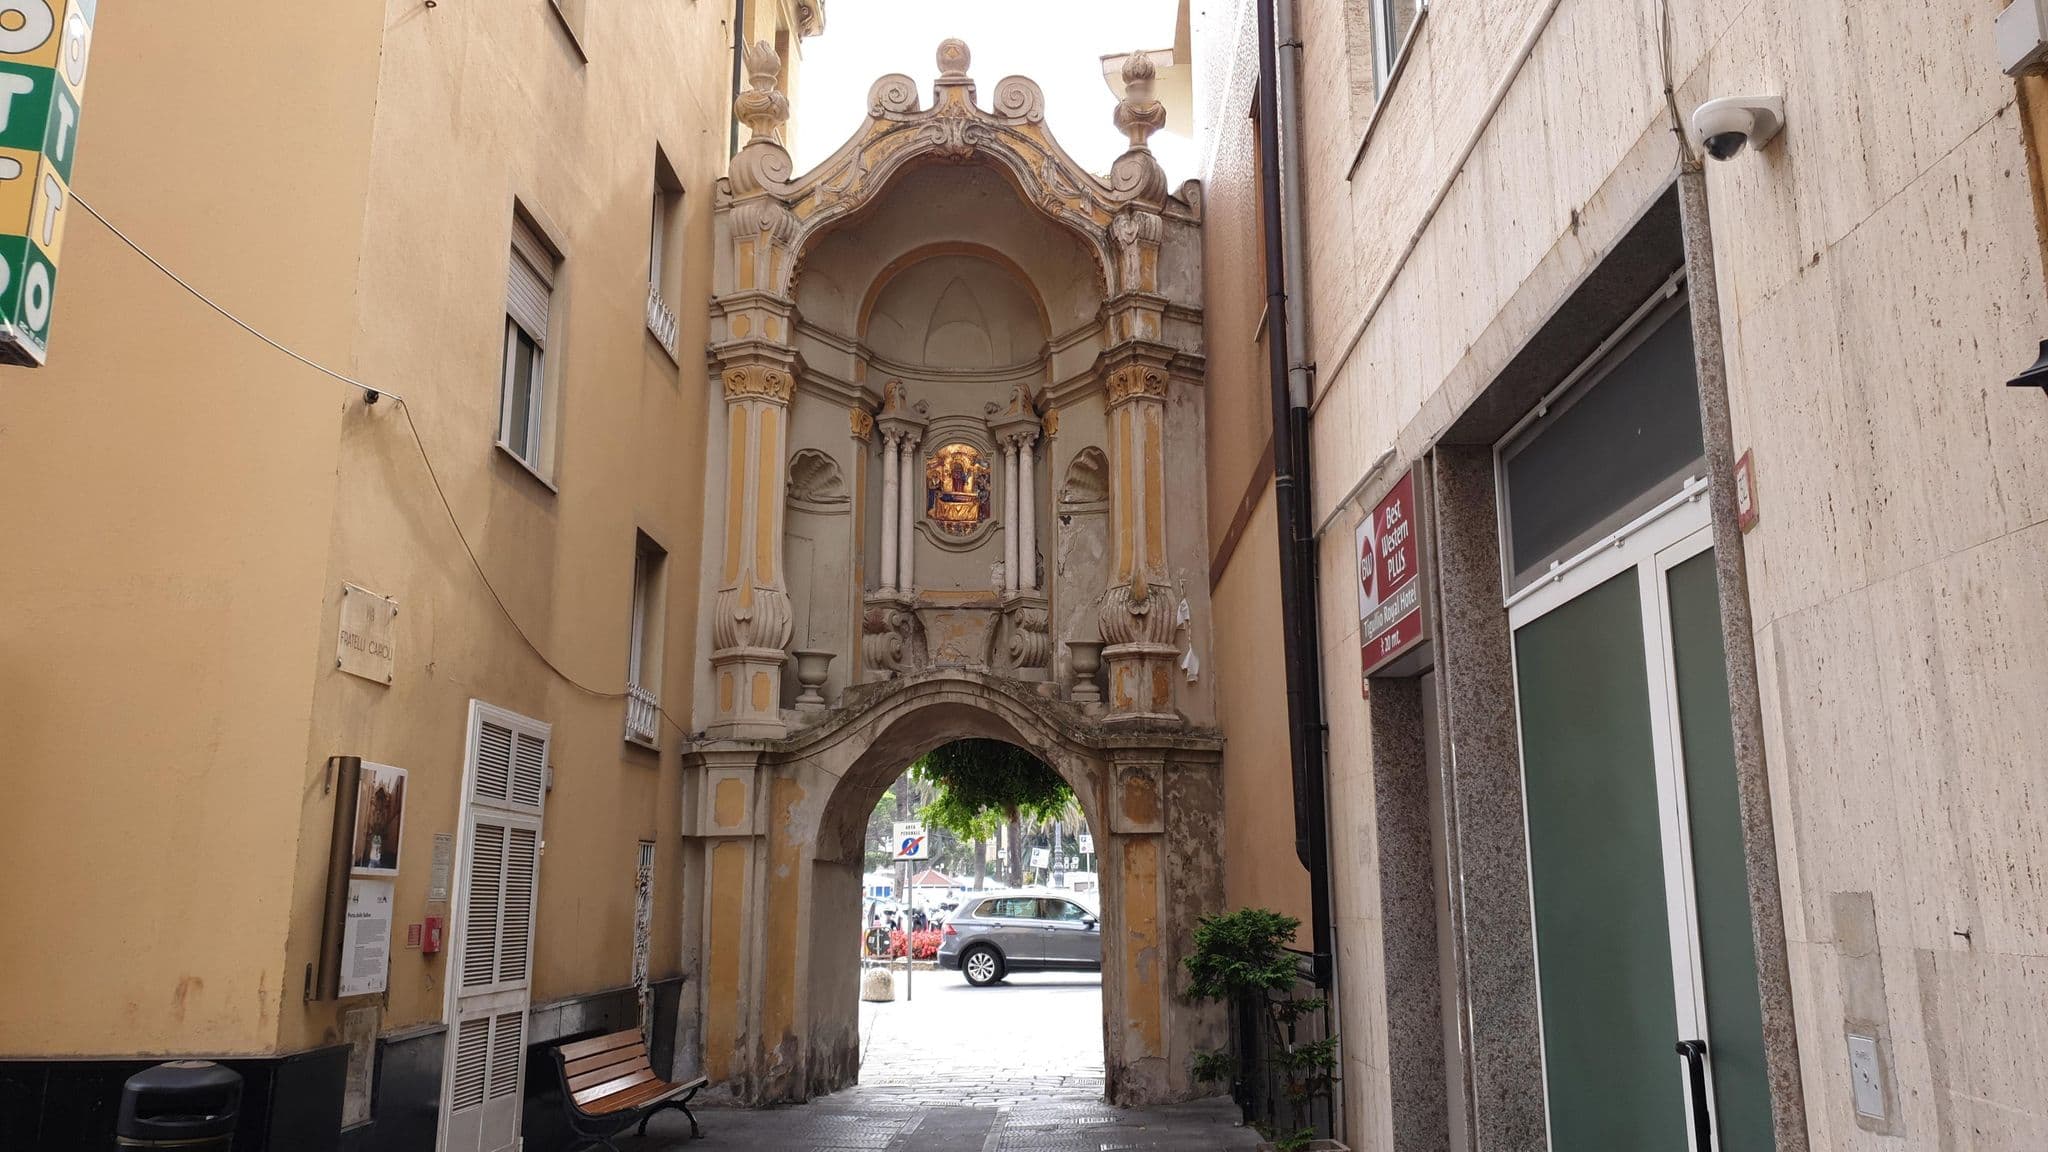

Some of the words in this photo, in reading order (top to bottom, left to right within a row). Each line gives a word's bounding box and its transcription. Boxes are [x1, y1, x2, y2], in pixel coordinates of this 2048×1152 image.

[1386, 499, 1401, 529] Best
[1381, 520, 1408, 558] Western
[1361, 552, 1373, 581] BW
[1387, 547, 1406, 581] PLUS
[1383, 595, 1399, 623] Royal
[1400, 581, 1417, 611] Hotel
[1384, 635, 1391, 652] 20
